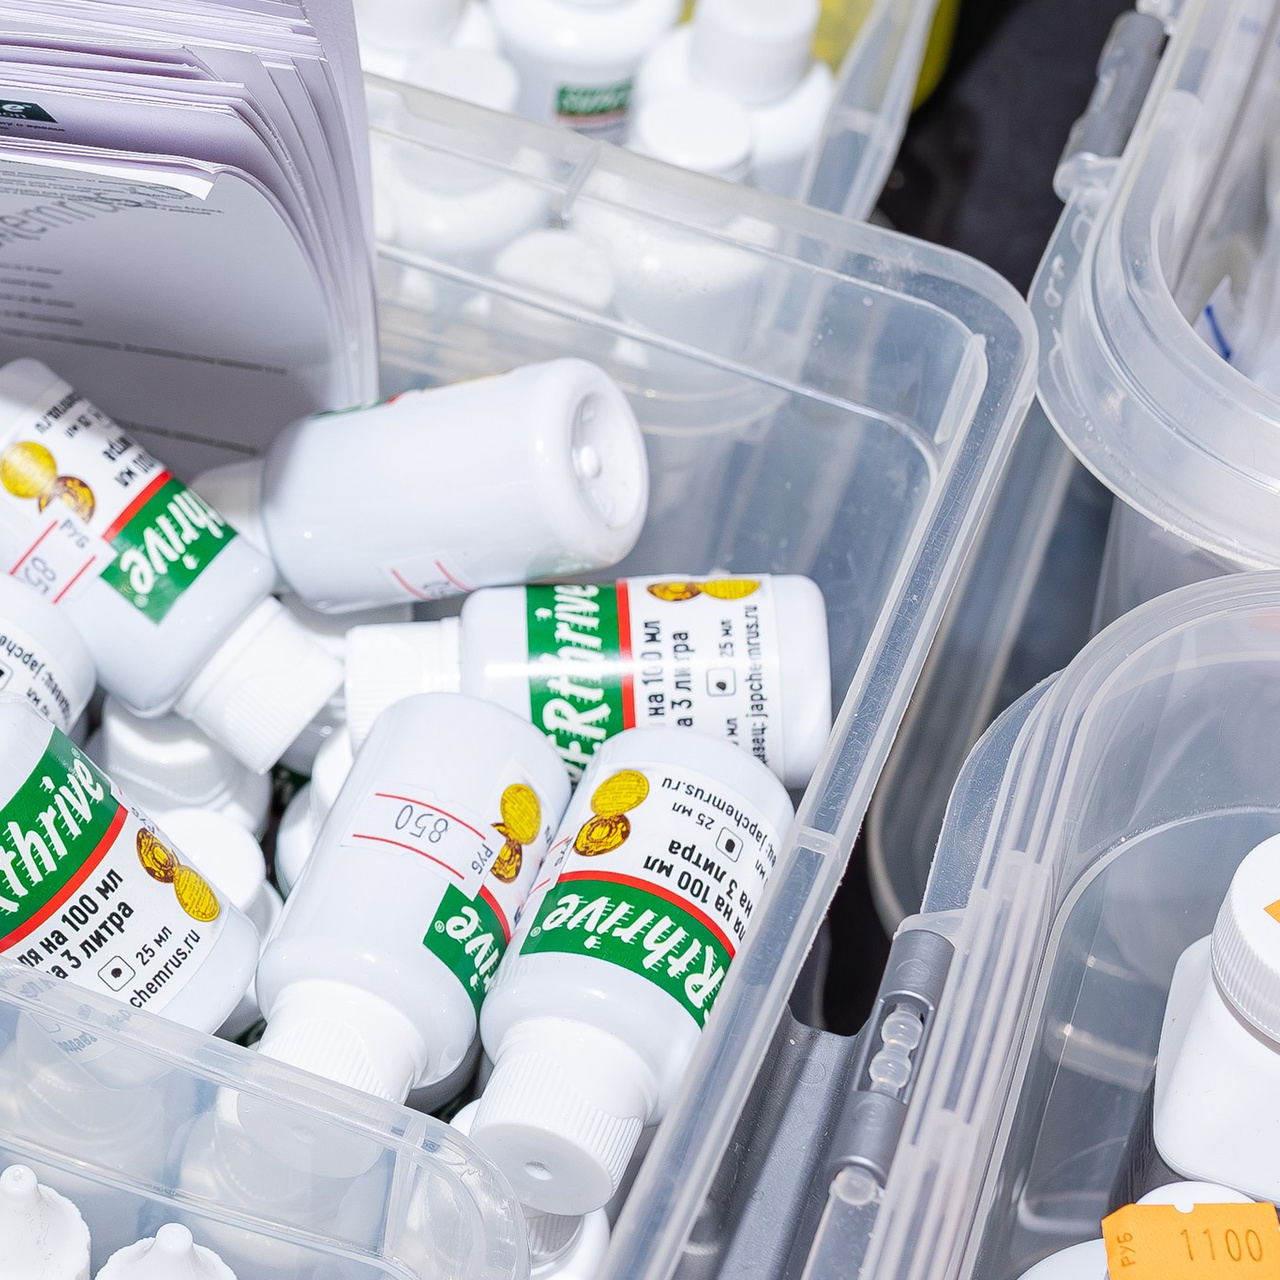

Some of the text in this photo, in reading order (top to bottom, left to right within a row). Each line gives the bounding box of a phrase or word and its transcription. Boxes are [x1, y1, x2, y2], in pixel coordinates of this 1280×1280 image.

[644, 621, 661, 643] мл
[718, 641, 734, 656] 25
[720, 620, 732, 637] мл
[647, 693, 665, 717] на
[670, 699, 693, 710] 3
[661, 777, 768, 848] japchemrus.ru
[671, 802, 693, 817] мл
[695, 812, 715, 831] 25
[394, 804, 494, 875] 850 РУБ
[668, 839, 727, 884] литра
[642, 855, 733, 922] на 100 мл
[725, 878, 738, 900] 3
[38, 869, 124, 955] на 100 мл
[60, 948, 91, 969] 3
[78, 901, 135, 959] литра
[135, 925, 173, 967] 25 мл
[544, 894, 725, 1015] Rthrive
[129, 929, 201, 1009] chemrus.ru
[1116, 1228, 1264, 1268] РУБ 1100
